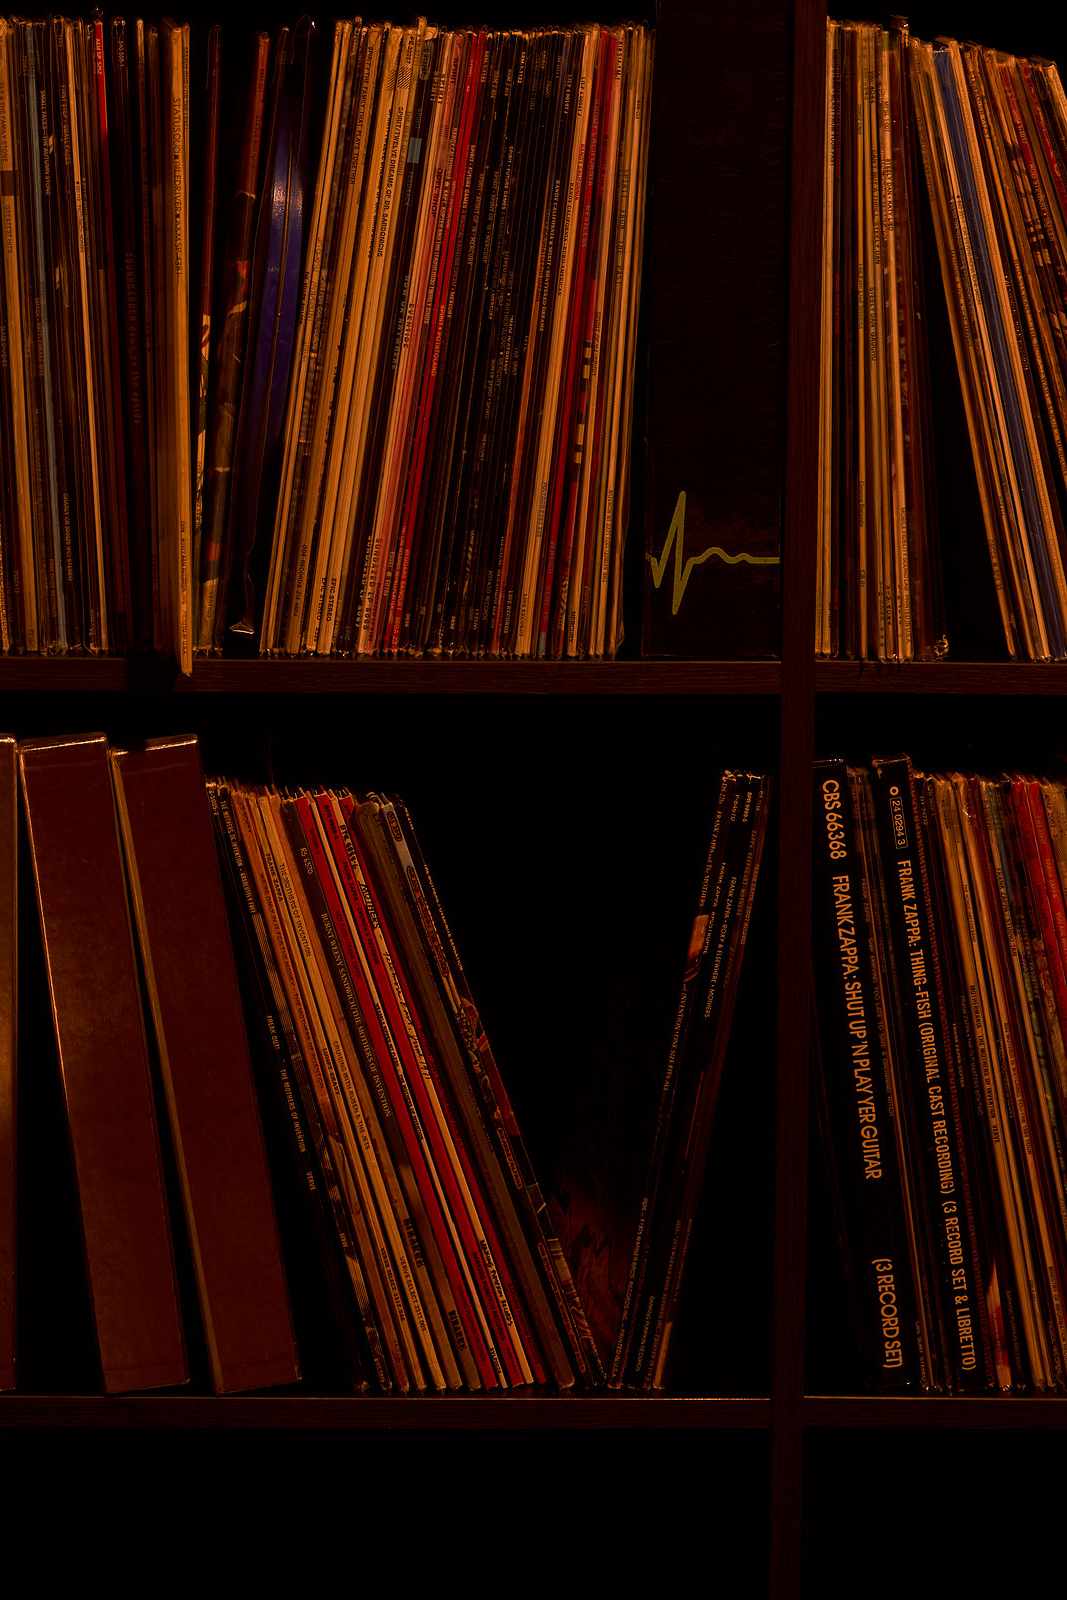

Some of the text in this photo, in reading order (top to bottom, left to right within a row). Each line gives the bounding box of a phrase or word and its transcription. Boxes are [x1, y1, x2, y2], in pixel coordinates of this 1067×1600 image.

[386, 159, 397, 188] DREAMS
[377, 214, 390, 258] SARDONICUS
[326, 595, 335, 622] STEREO
[822, 779, 847, 860] CBS 66368
[892, 800, 902, 812] 24
[893, 814, 905, 837] 0294
[832, 875, 853, 926] FRANK
[321, 912, 335, 939] BURNT
[330, 940, 344, 967] WEENY
[837, 927, 860, 980] ZAPPA:
[843, 981, 864, 1018] SHUT
[356, 1025, 373, 1061] MOTHERS
[849, 1018, 867, 1039] UP
[279, 1069, 288, 1080] THE
[369, 1062, 378, 1072] OF
[852, 1058, 876, 1097] PLAY
[282, 1082, 295, 1111] MOTHERS
[372, 1074, 392, 1118] INVENTION
[857, 1096, 879, 1124] YER
[897, 859, 977, 1371] FRANK ZAPPA: THING-FISH (ORIGINAL CAST RECORDING) (3 RECORD SET & LIBRETTO)
[290, 1121, 306, 1153] INVENTION
[861, 1125, 883, 1180] GUITAR
[305, 1171, 315, 1191] VERVE
[871, 1258, 903, 1369] (3 RECORD SET)
